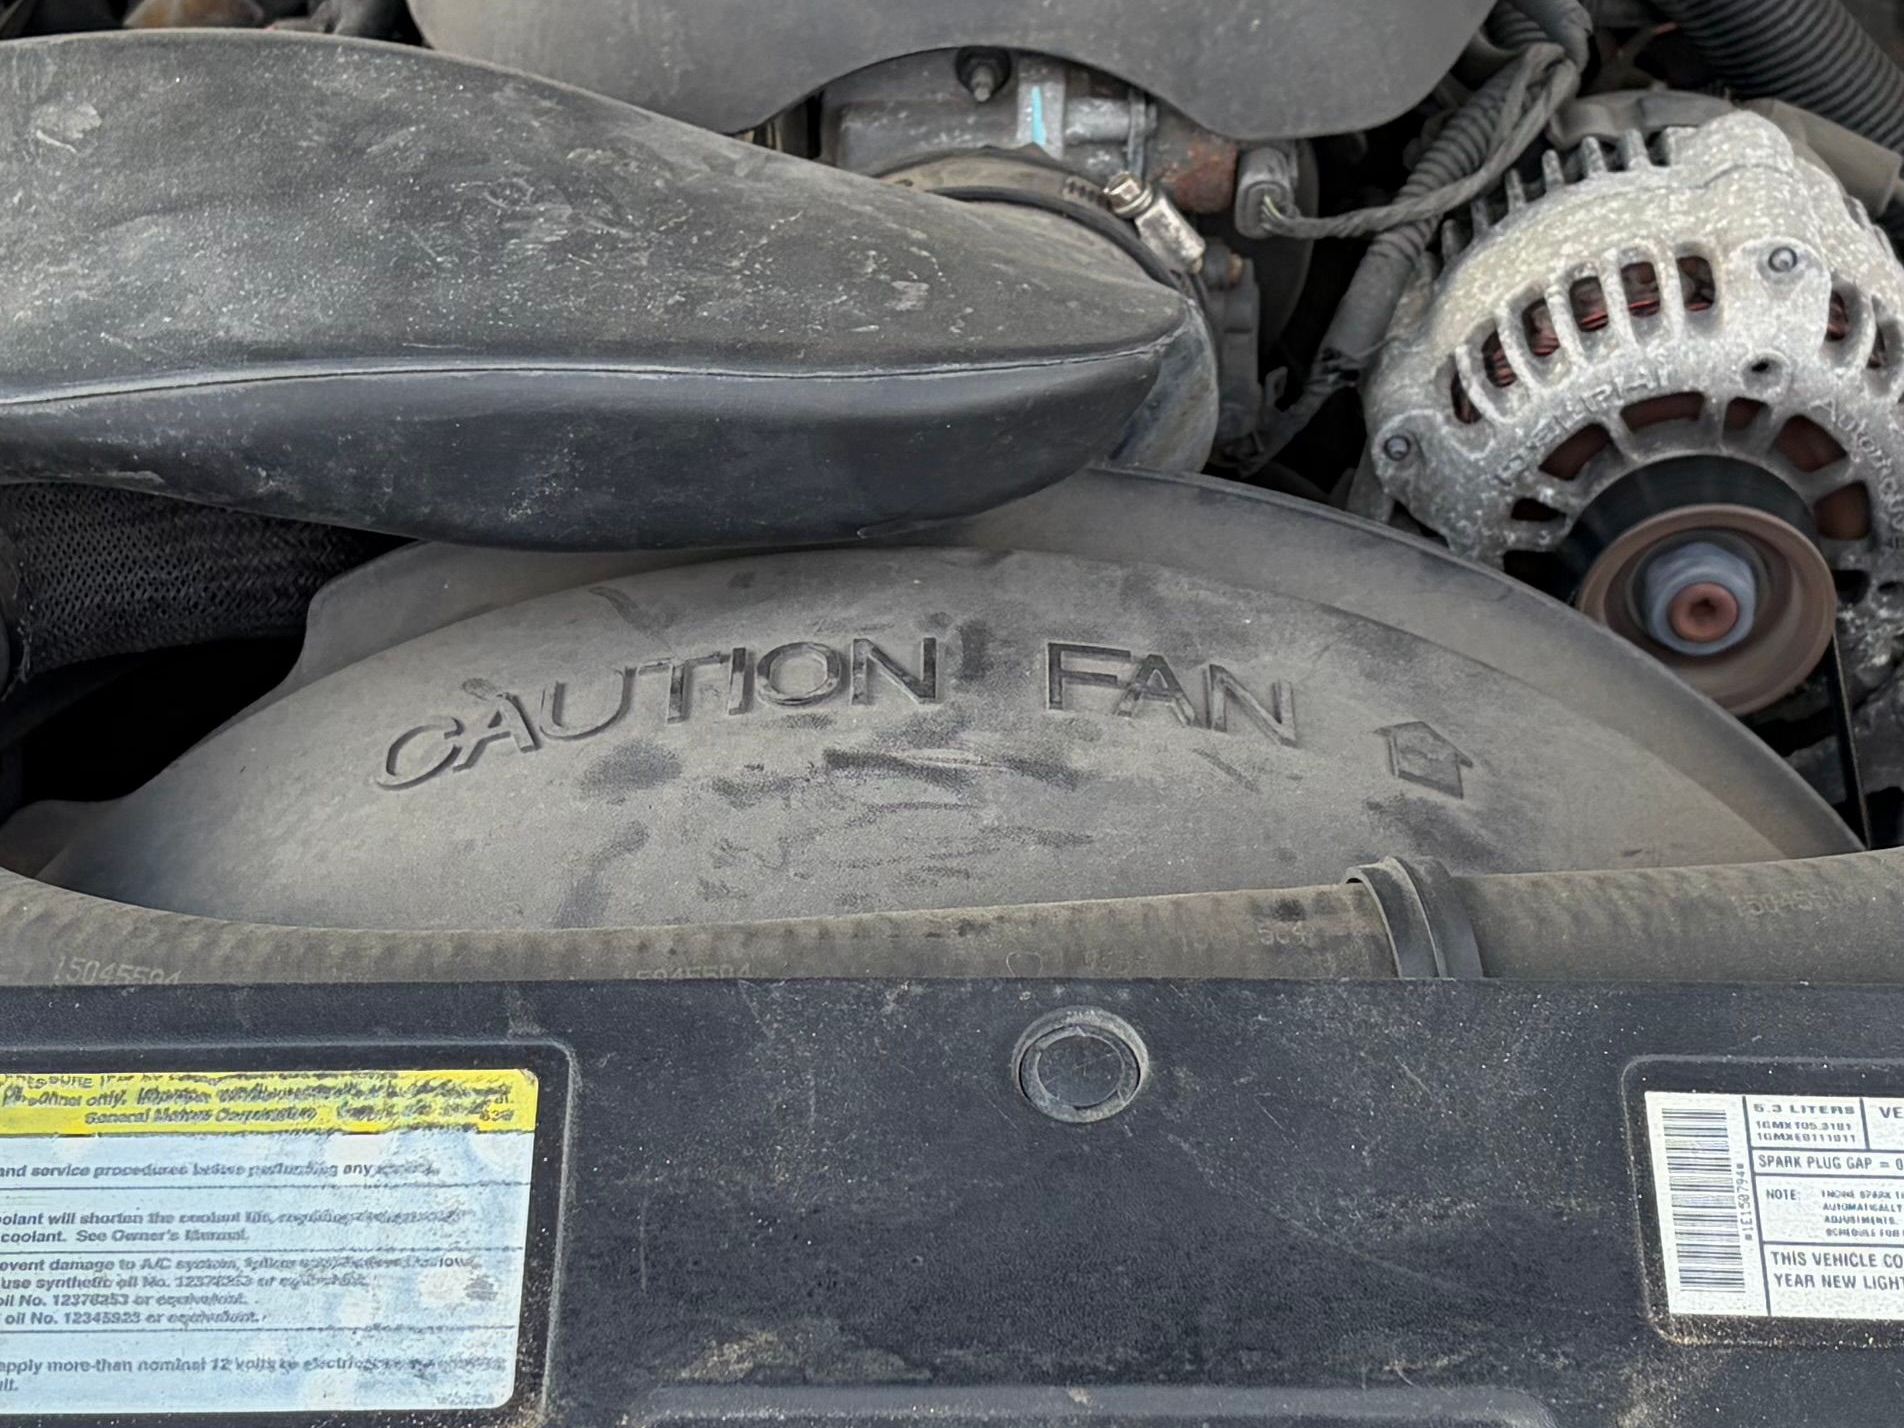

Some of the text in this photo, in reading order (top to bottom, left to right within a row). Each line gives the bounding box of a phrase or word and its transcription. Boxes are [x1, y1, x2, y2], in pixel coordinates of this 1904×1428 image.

[369, 635, 1302, 791] CAUTION FAN
[1790, 1105, 1856, 1116] LITERS
[1757, 1154, 1802, 1169] SPARK
[1806, 1155, 1842, 1171] PLUG
[1846, 1156, 1873, 1171] GAP
[31, 1164, 89, 1179] service
[93, 1163, 188, 1182] procedures
[343, 1162, 371, 1178] any
[1767, 1188, 1801, 1202] NOTE:
[48, 1212, 76, 1226] will
[80, 1211, 144, 1226] shorten
[147, 1211, 172, 1225] the
[0, 1229, 67, 1244] coolant.
[77, 1229, 108, 1243] See
[49, 1258, 115, 1275] damage
[140, 1257, 172, 1271] A/C
[1770, 1251, 1807, 1268] THIS
[1813, 1252, 1877, 1269] VEHICLE
[0, 1278, 30, 1291] use
[35, 1276, 113, 1293] synthetic
[1773, 1273, 1815, 1289] YEAR
[1821, 1274, 1857, 1290] NEW
[19, 1294, 47, 1308] No.
[5, 1312, 26, 1326] oil
[30, 1312, 59, 1326] No.
[137, 1357, 206, 1372] nominal
[210, 1357, 232, 1371] 12
